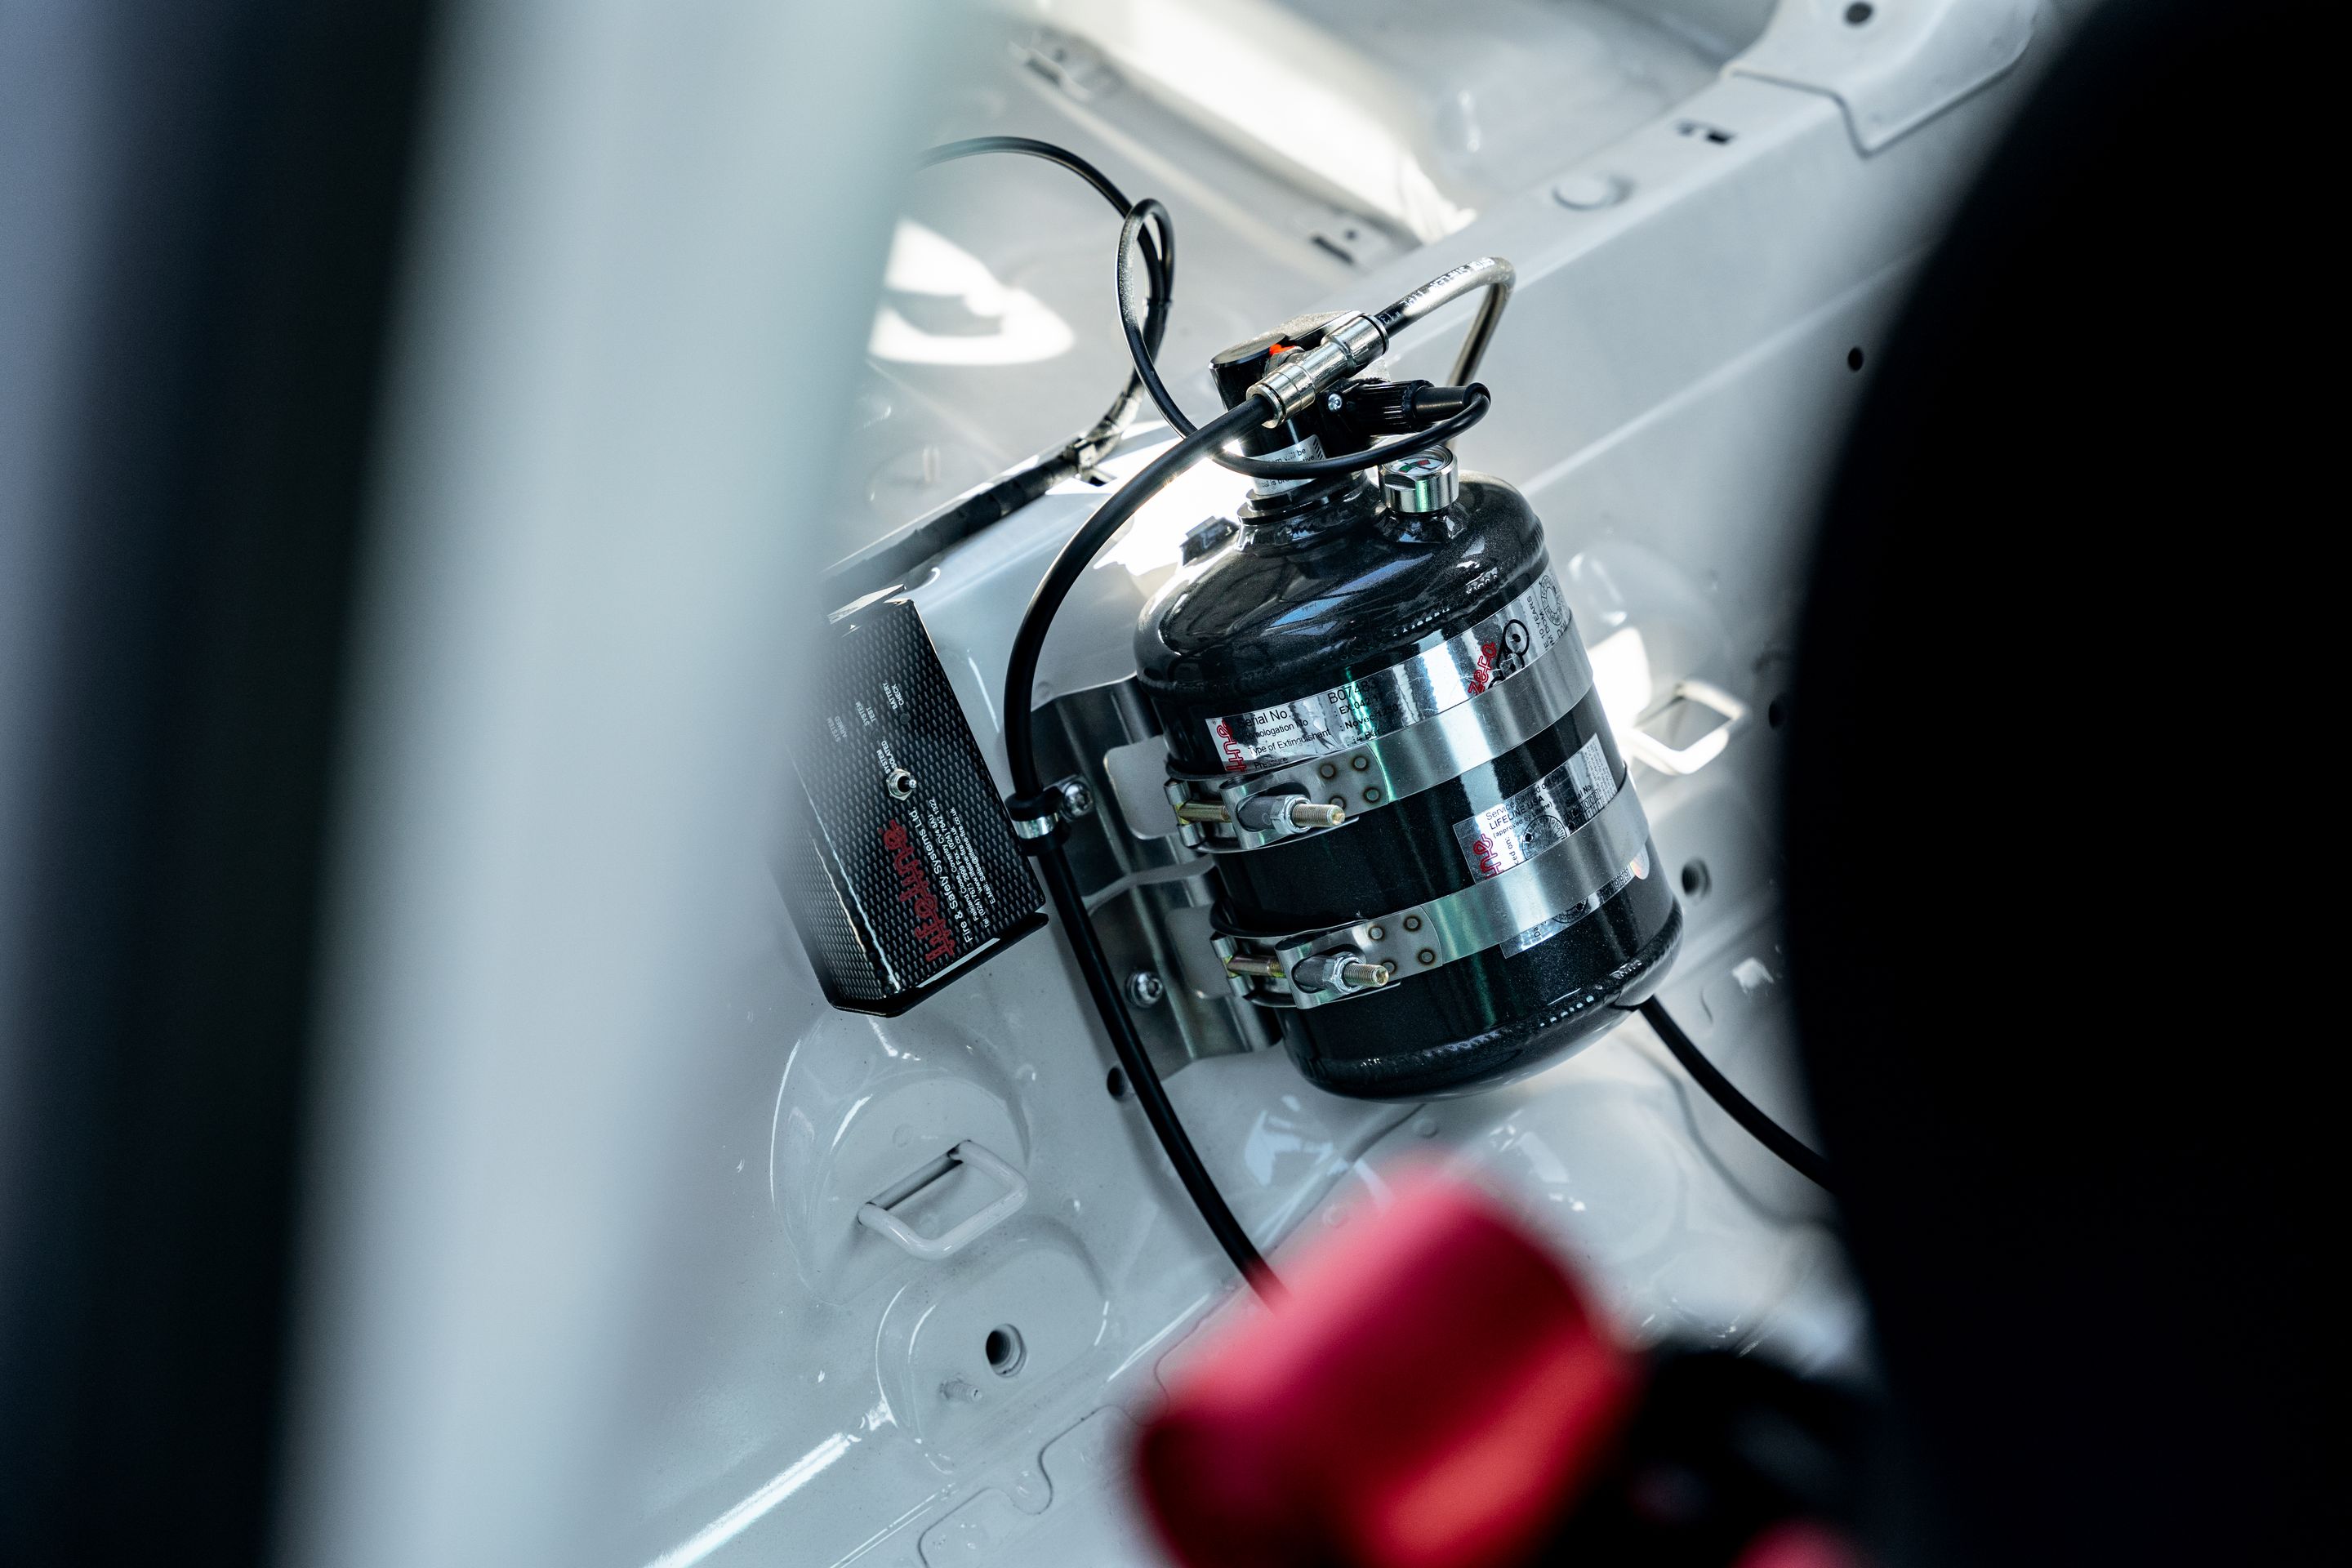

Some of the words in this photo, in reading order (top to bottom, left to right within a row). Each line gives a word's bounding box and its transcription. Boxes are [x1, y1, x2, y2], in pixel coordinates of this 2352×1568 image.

[1296, 448, 1306, 456] be
[1527, 596, 1541, 628] YEARS
[1539, 629, 1546, 639] 10
[882, 682, 898, 710] BATTERY
[891, 683, 904, 706] CHECK
[855, 701, 870, 726] SYSTEM
[865, 706, 876, 722] TEST
[1271, 709, 1291, 721] No.
[1296, 719, 1309, 728] No
[826, 716, 840, 742] SYSTEM
[834, 715, 847, 737] ARMED
[1248, 743, 1267, 756] Type
[1268, 742, 1276, 751] of
[876, 749, 891, 774] SYSTEM
[1254, 756, 1289, 770] Pressure
[929, 797, 939, 814] 1322
[1486, 800, 1516, 821] Service
[1490, 806, 1526, 830] LIFELINE
[1527, 795, 1544, 809] USA
[908, 806, 922, 828] Ltd.
[927, 813, 938, 828] 8AU
[934, 829, 944, 844] CV4
[944, 831, 956, 849] (024)
[950, 806, 986, 881] Sales@lifeline-fire.co.uk
[919, 828, 942, 874] Systems
[942, 844, 957, 872] Coventry
[950, 826, 982, 893] www.lifeline-fire.co.uk
[884, 818, 956, 961] lifeline
[939, 875, 958, 909] Safety
[956, 871, 966, 893] Close,
[954, 909, 963, 920] &
[963, 893, 978, 921] Falkland
[973, 898, 986, 915] (024)
[960, 920, 973, 942] Fire
